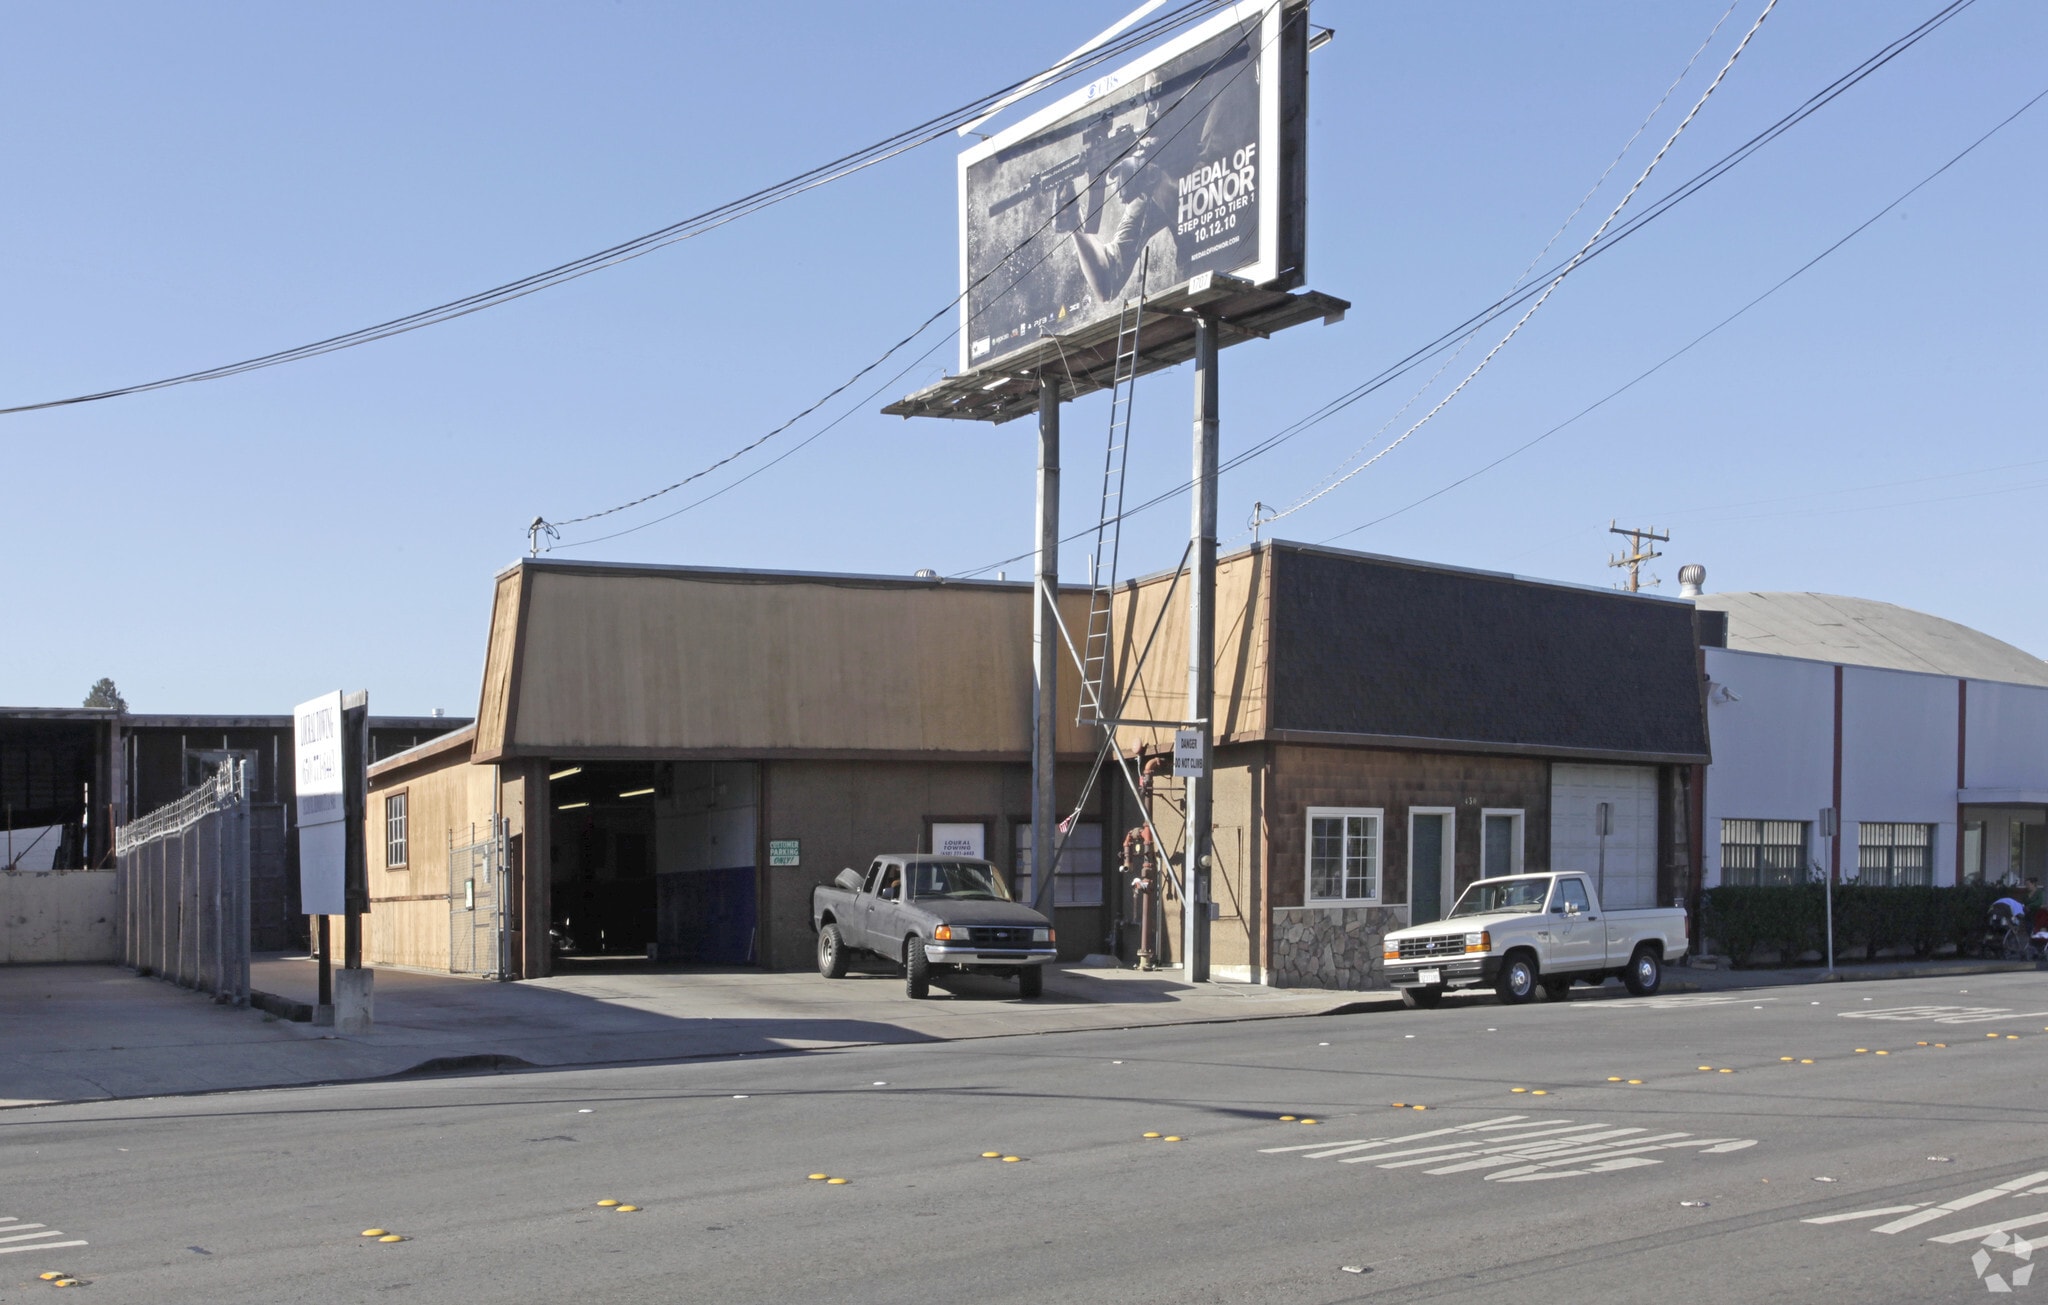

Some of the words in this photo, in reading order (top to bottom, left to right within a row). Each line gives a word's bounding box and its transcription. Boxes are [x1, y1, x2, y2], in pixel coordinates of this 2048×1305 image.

[1179, 157, 1230, 197] MEDAL
[1233, 142, 1256, 170] OF
[1178, 165, 1255, 224] HONOR
[1178, 217, 1199, 235] STEP
[1201, 211, 1213, 225] UP
[1214, 206, 1226, 219] TO
[1228, 196, 1248, 213] TIER
[1250, 192, 1255, 203] 1
[1195, 214, 1236, 243] 10.12.10
[1181, 738, 1197, 749] DANGER
[1182, 758, 1190, 768] NOT
[769, 848, 799, 856] PARKING
[1257, 1115, 1759, 1183] XING
